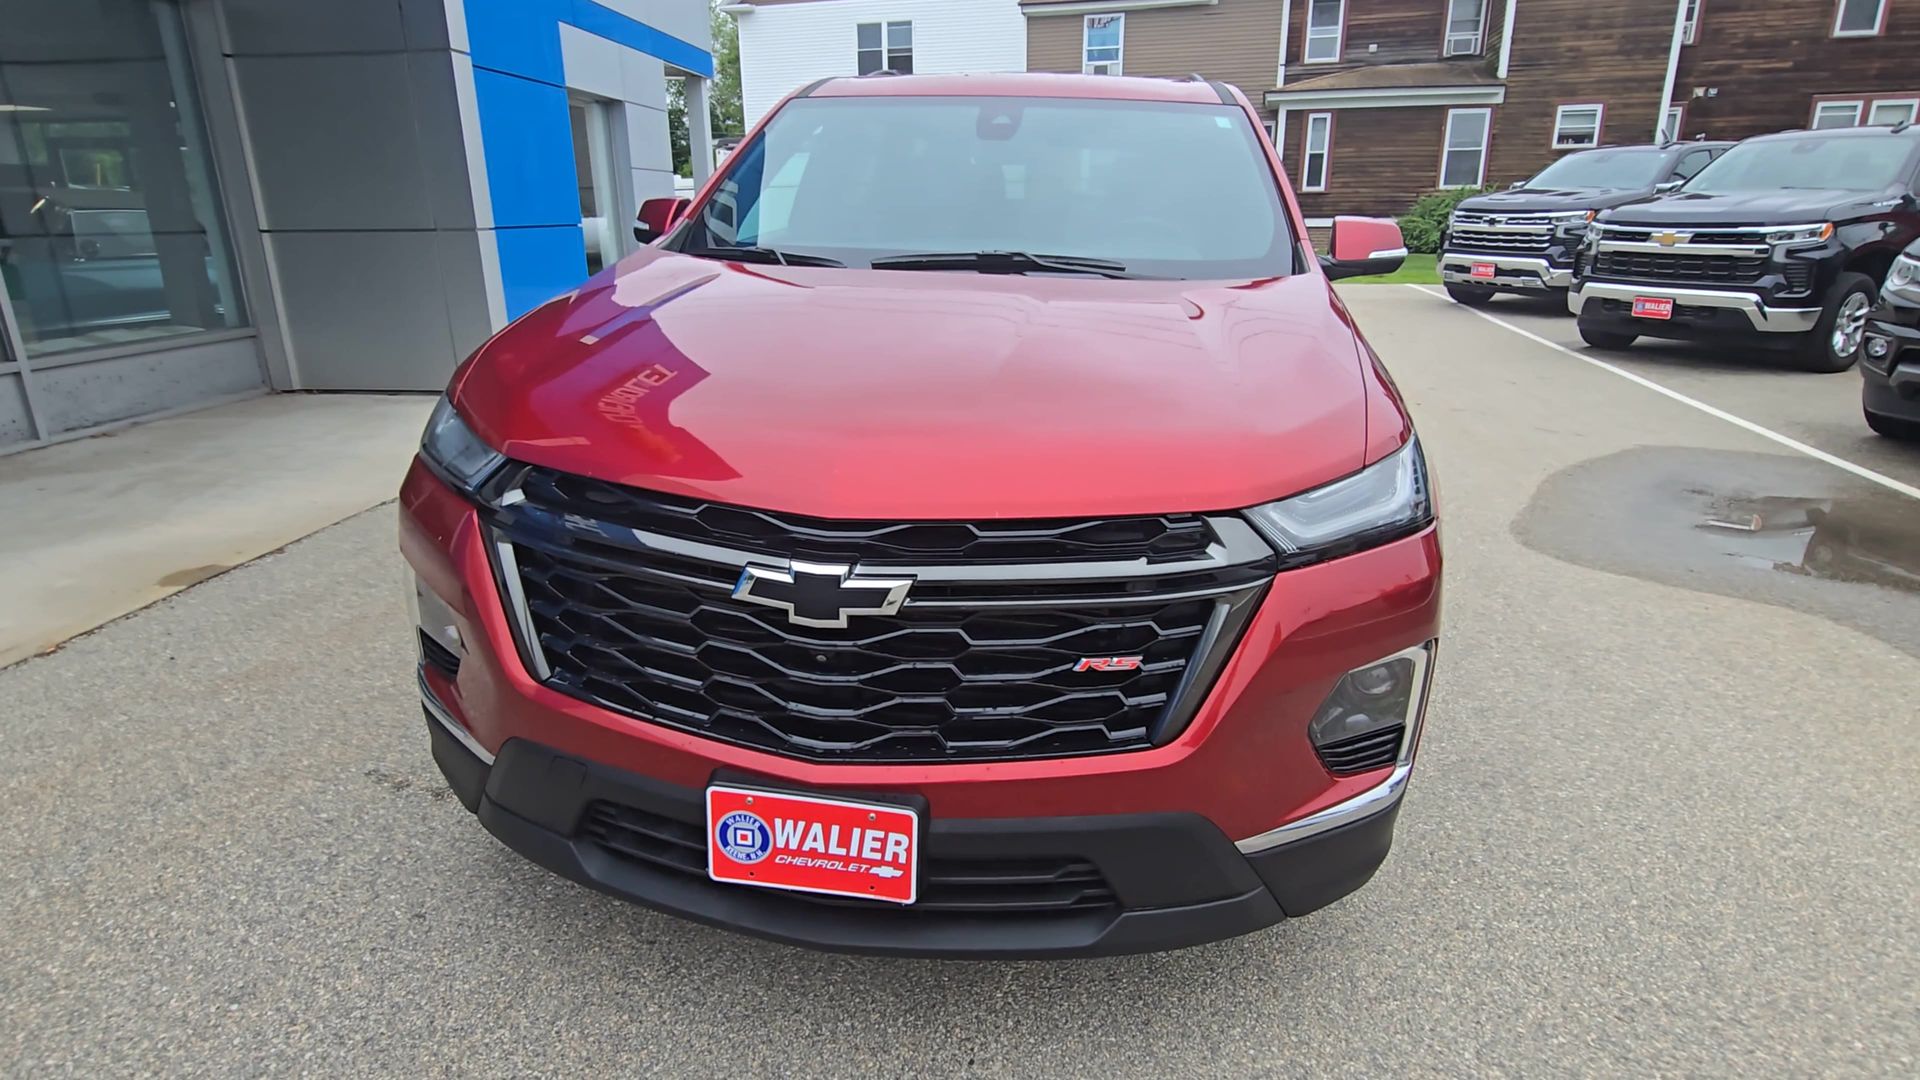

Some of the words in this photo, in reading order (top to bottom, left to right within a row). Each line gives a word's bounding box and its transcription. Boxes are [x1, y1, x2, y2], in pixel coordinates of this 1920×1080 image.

[1072, 655, 1144, 672] RS
[726, 814, 761, 829] WALIER
[774, 817, 910, 864] WALIER
[774, 854, 871, 873] CHEVROLET
